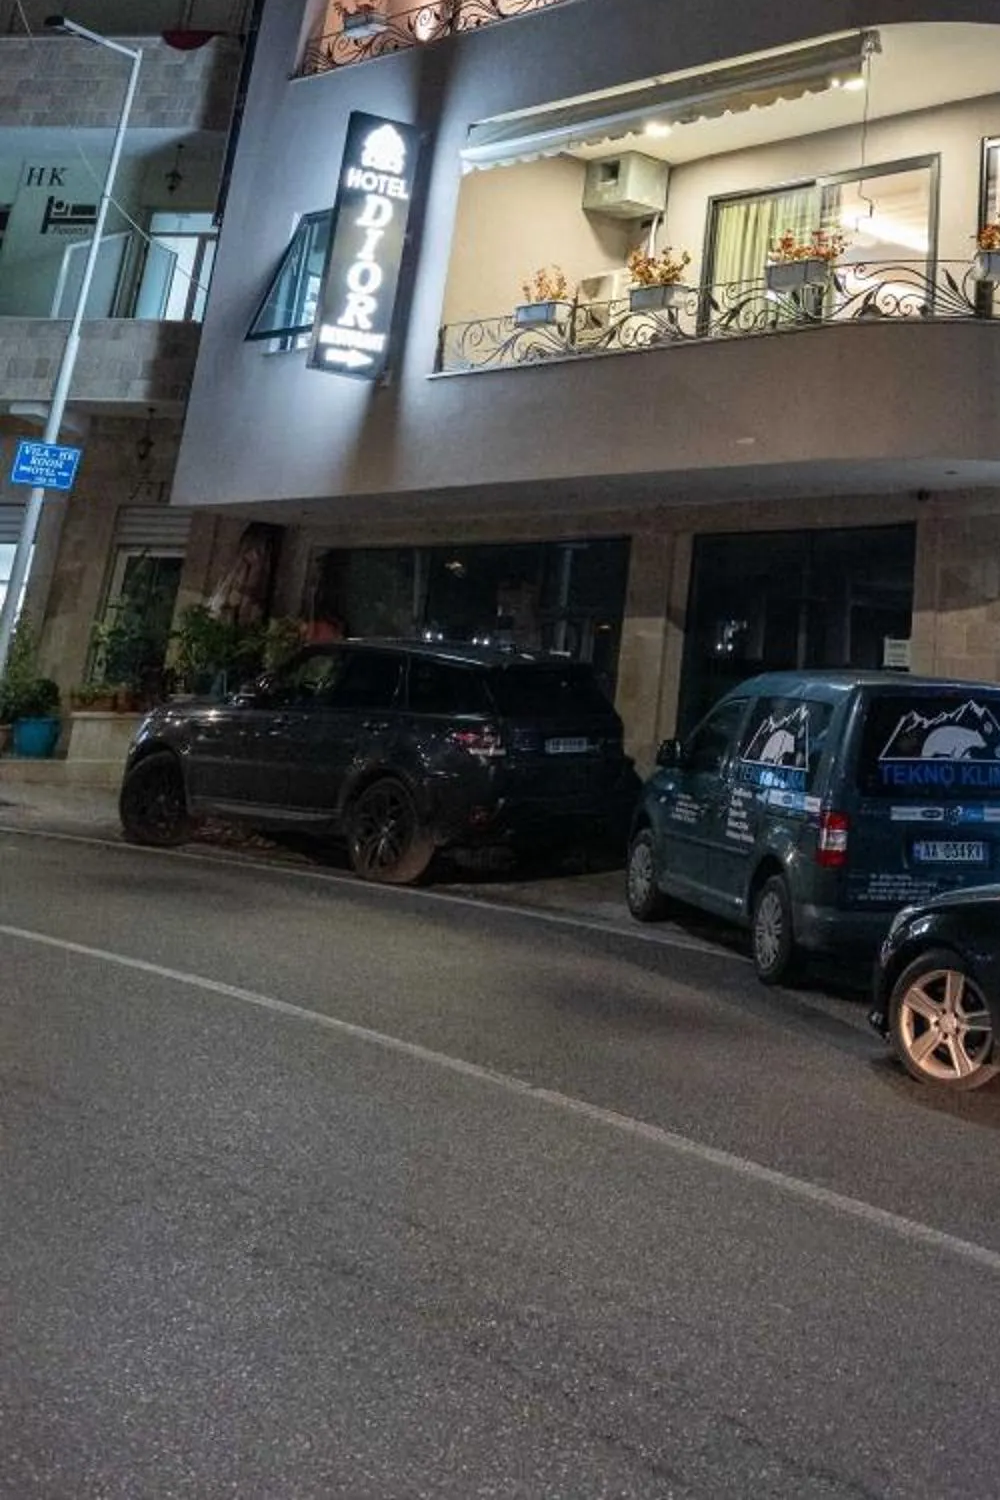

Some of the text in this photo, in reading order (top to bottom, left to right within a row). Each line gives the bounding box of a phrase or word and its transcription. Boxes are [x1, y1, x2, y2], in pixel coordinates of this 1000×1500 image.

[346, 166, 409, 200] HOTEL
[337, 193, 394, 331] DIOR
[881, 763, 956, 788] TEKNO
